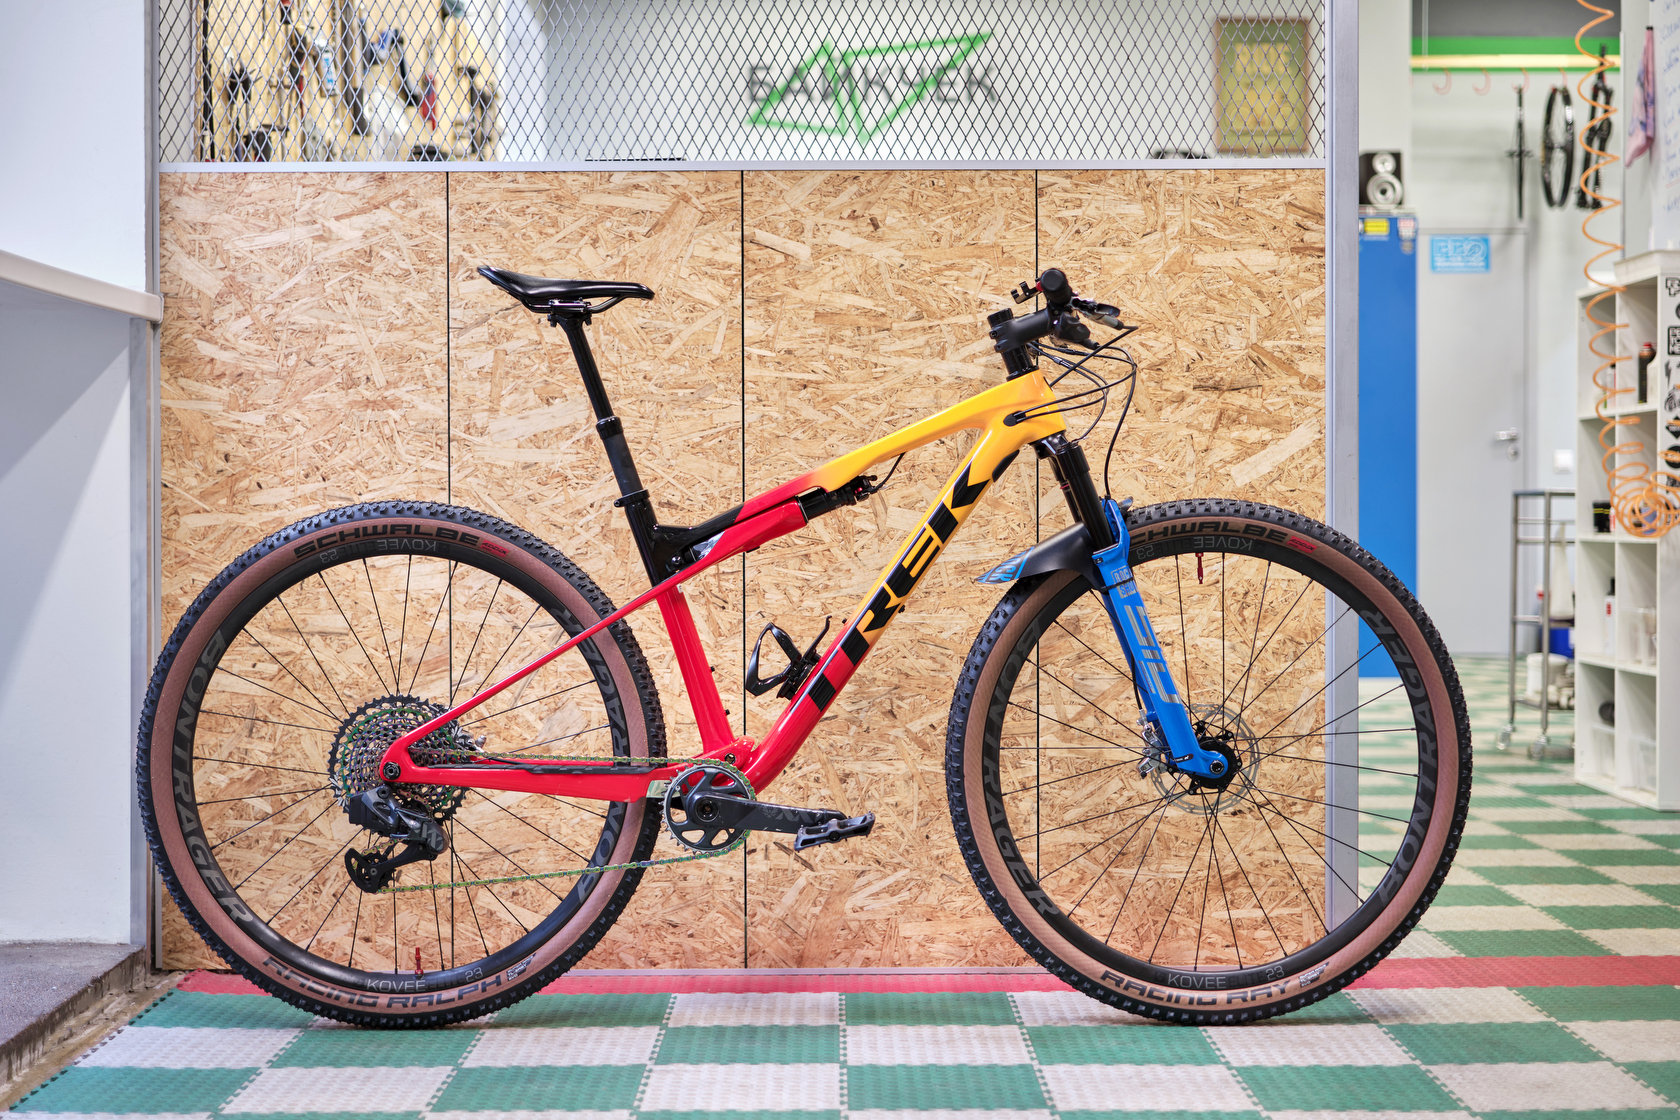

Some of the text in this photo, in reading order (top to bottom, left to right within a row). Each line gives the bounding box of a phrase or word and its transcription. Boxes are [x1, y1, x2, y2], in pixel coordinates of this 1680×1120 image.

[294, 524, 480, 559] SCHWALBE
[377, 538, 437, 552] KOVEE
[1130, 521, 1289, 546] CHWALBE
[1193, 535, 1253, 550] KOVEE
[320, 549, 338, 564] 23
[808, 461, 990, 711] TREK
[552, 608, 629, 901] BONRAGER
[983, 618, 1060, 917] BONTRAGER
[1363, 609, 1438, 908] BONTRAGER
[173, 629, 254, 923] BONTRAGER
[263, 956, 502, 1009] RACING RALPH
[366, 978, 426, 993] KOVEE
[465, 967, 483, 982] 23
[1101, 969, 1217, 1006] RACING
[1227, 980, 1291, 1004] RAY
[1168, 973, 1227, 989] KOVEE
[1265, 966, 1285, 981] 23
